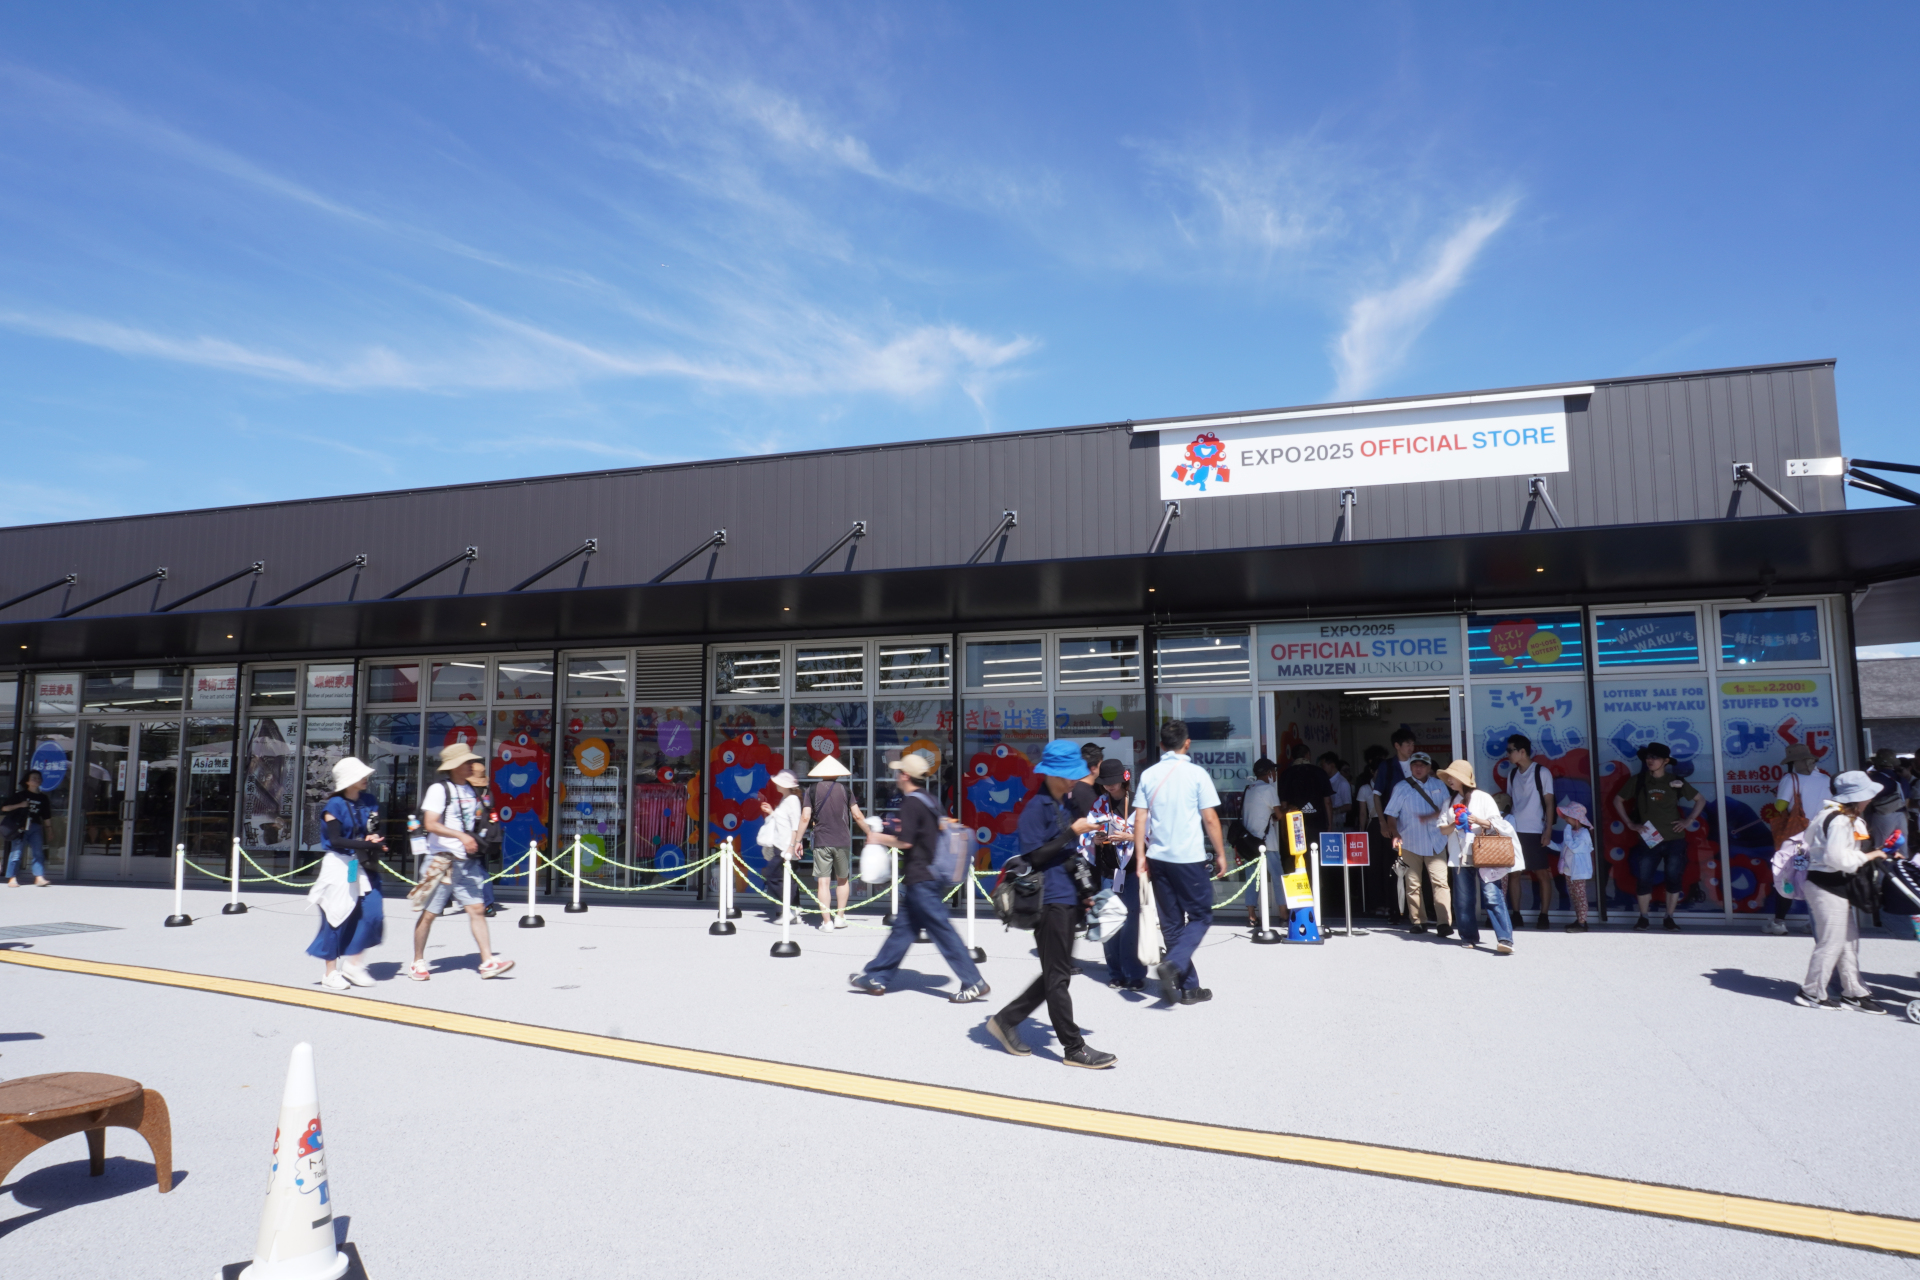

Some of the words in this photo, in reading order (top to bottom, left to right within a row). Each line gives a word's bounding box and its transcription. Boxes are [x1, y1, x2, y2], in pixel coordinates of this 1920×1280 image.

[1241, 442, 1354, 467] EXPO2025
[1360, 434, 1467, 457] OFFICIAL
[1472, 426, 1555, 449] STORE
[1320, 624, 1396, 638] EXPO2025
[1493, 629, 1524, 643] ハズレ
[1270, 641, 1368, 660] OFFICIAL
[1372, 638, 1448, 657] STORE
[1530, 638, 1557, 650] NO-LOSE
[1532, 645, 1560, 657] LOTTERY!
[1278, 662, 1356, 677] MARUZEN
[1359, 660, 1443, 675] JUNKUDO
[198, 678, 236, 691] 美術工芸
[1489, 685, 1543, 709] ミャク
[1603, 689, 1648, 698] LOTTERY
[1653, 688, 1677, 697] SALE
[1682, 688, 1704, 697] FOR
[1604, 700, 1706, 712] MYAKU-MYAKU
[1722, 698, 1778, 709] STUFFED
[1783, 697, 1819, 708] TOYS
[1521, 699, 1573, 725] ミャク
[193, 757, 230, 768] Asia物産
[1185, 752, 1247, 764] ARUZEN
[1727, 765, 1787, 781] 全長約80
[1350, 841, 1364, 849] 出口
